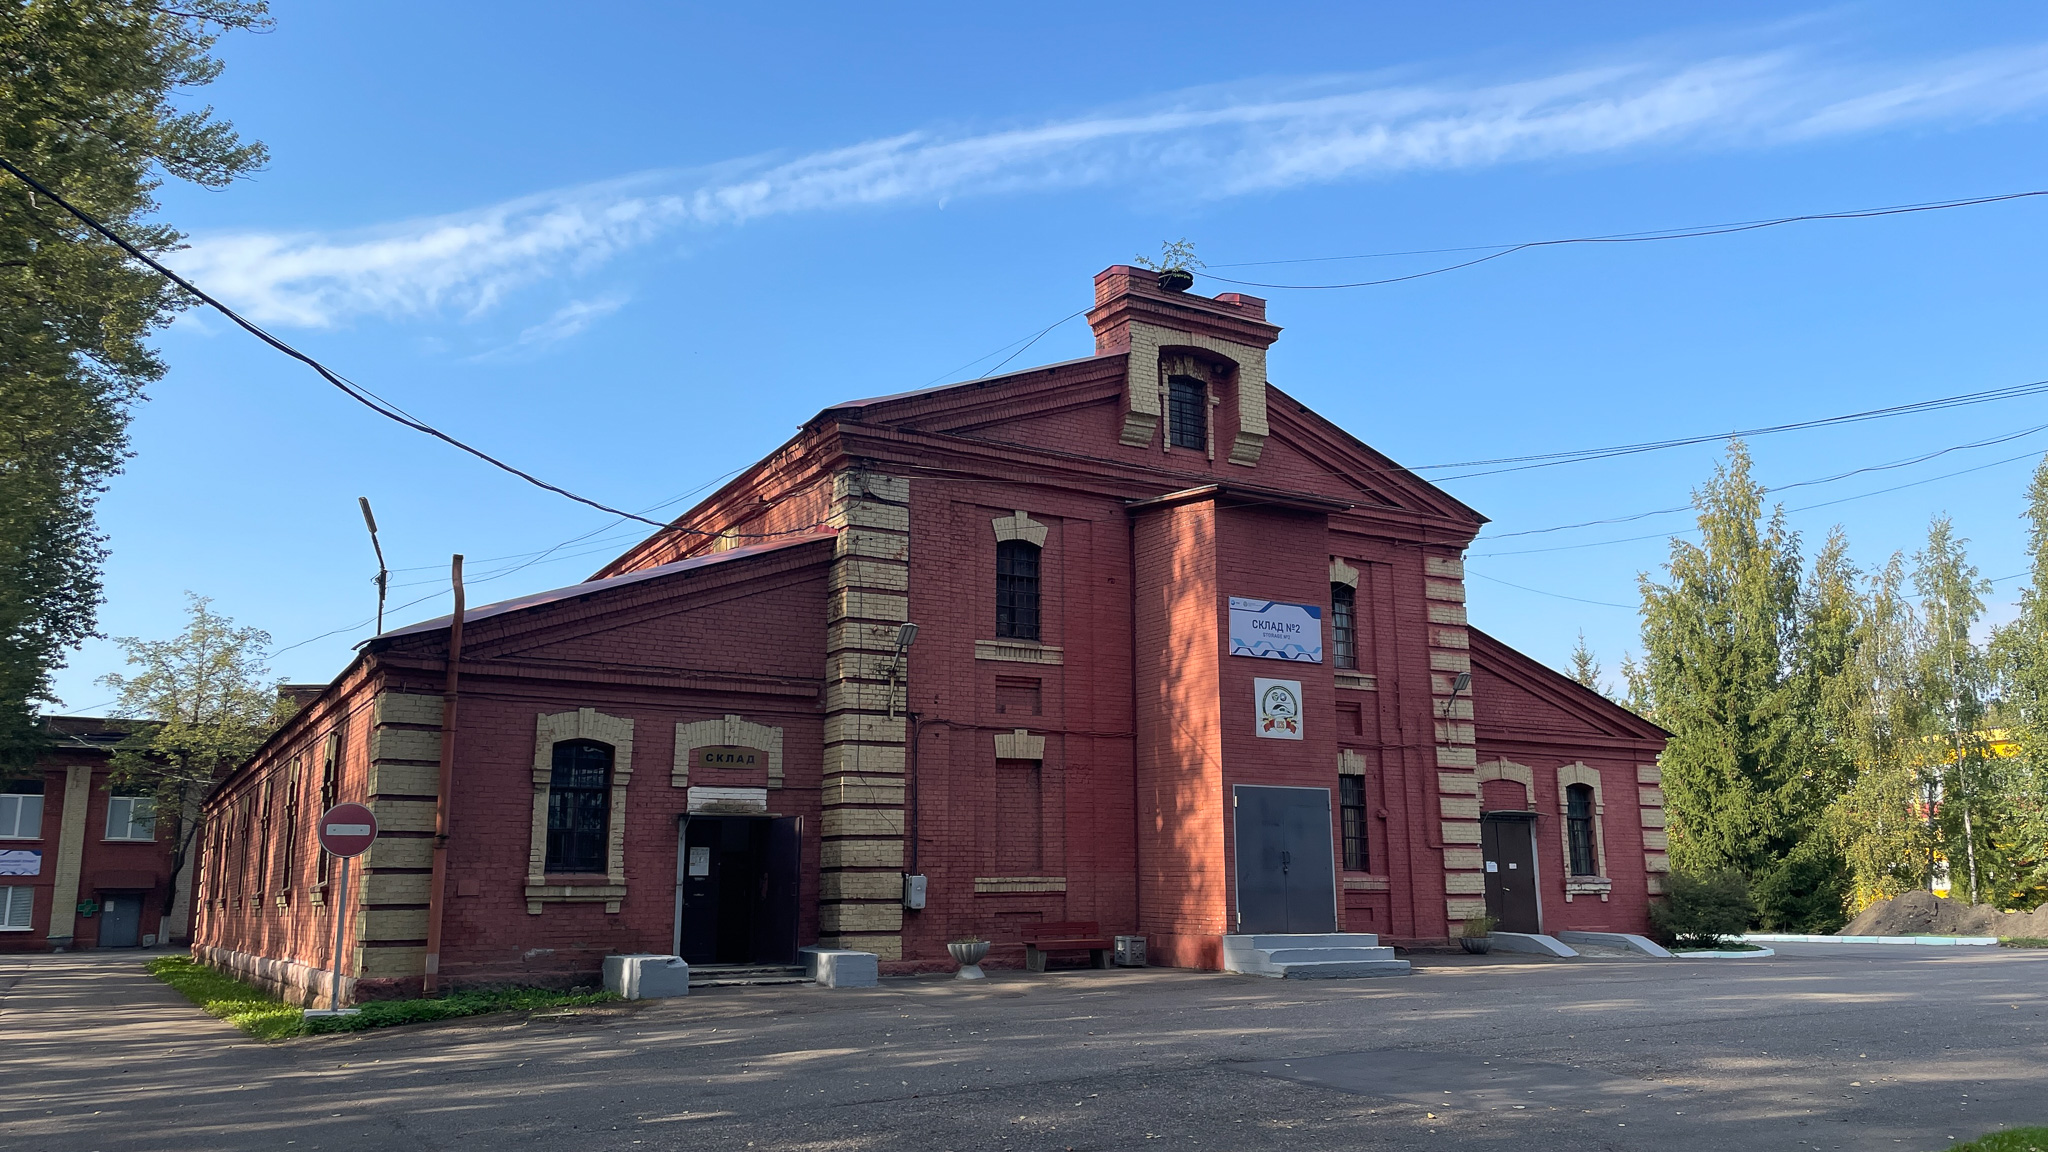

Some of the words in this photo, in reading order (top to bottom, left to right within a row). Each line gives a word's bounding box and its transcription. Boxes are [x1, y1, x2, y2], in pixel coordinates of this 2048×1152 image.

[1252, 619, 1284, 633] СКЛАД
[1286, 623, 1301, 634] №2
[705, 753, 755, 765] СКЛАД
